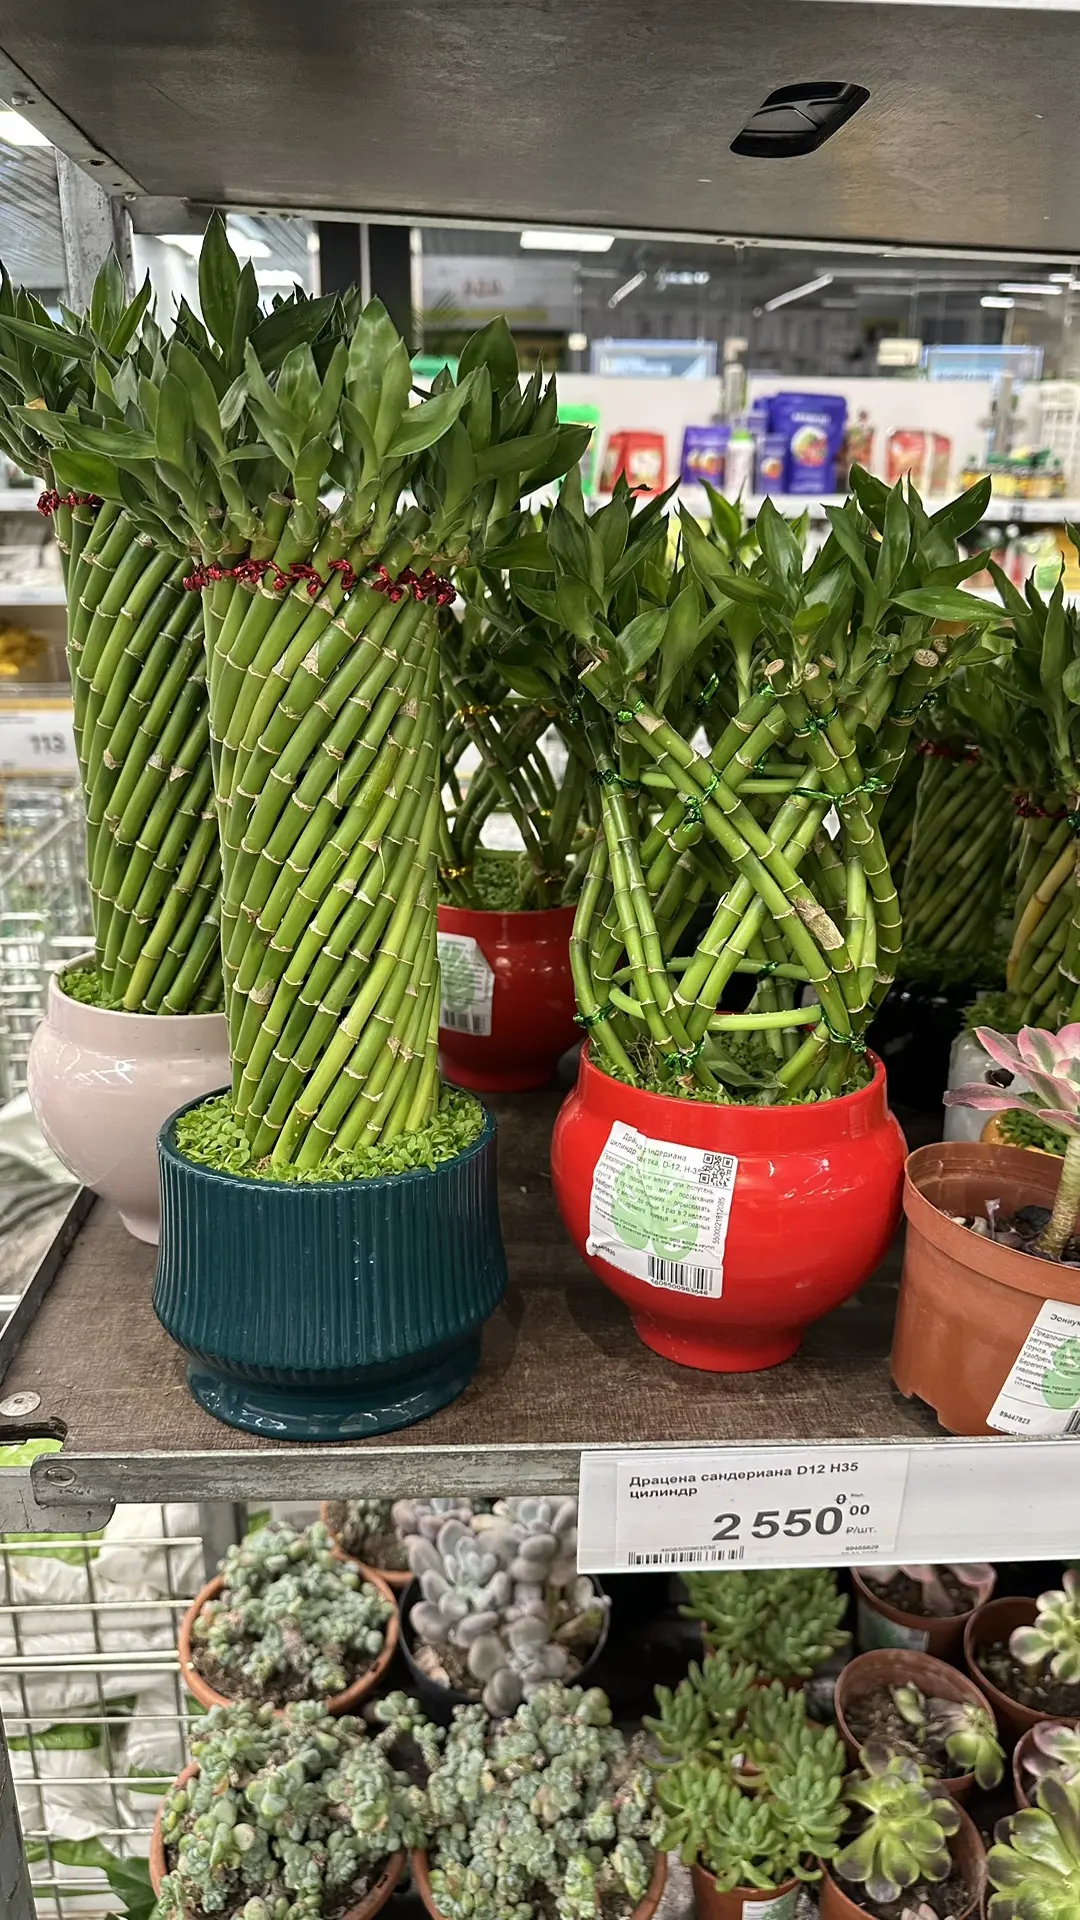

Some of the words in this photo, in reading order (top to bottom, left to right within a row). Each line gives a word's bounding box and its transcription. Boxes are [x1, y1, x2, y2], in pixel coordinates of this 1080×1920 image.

[609, 1138, 637, 1156] цилиндр
[629, 1474, 696, 1488] Драцена
[700, 1467, 792, 1484] сандериана
[796, 1464, 826, 1476] D12
[829, 1462, 860, 1474] H35
[629, 1486, 698, 1500] цилиндр
[849, 1504, 870, 1516] 00
